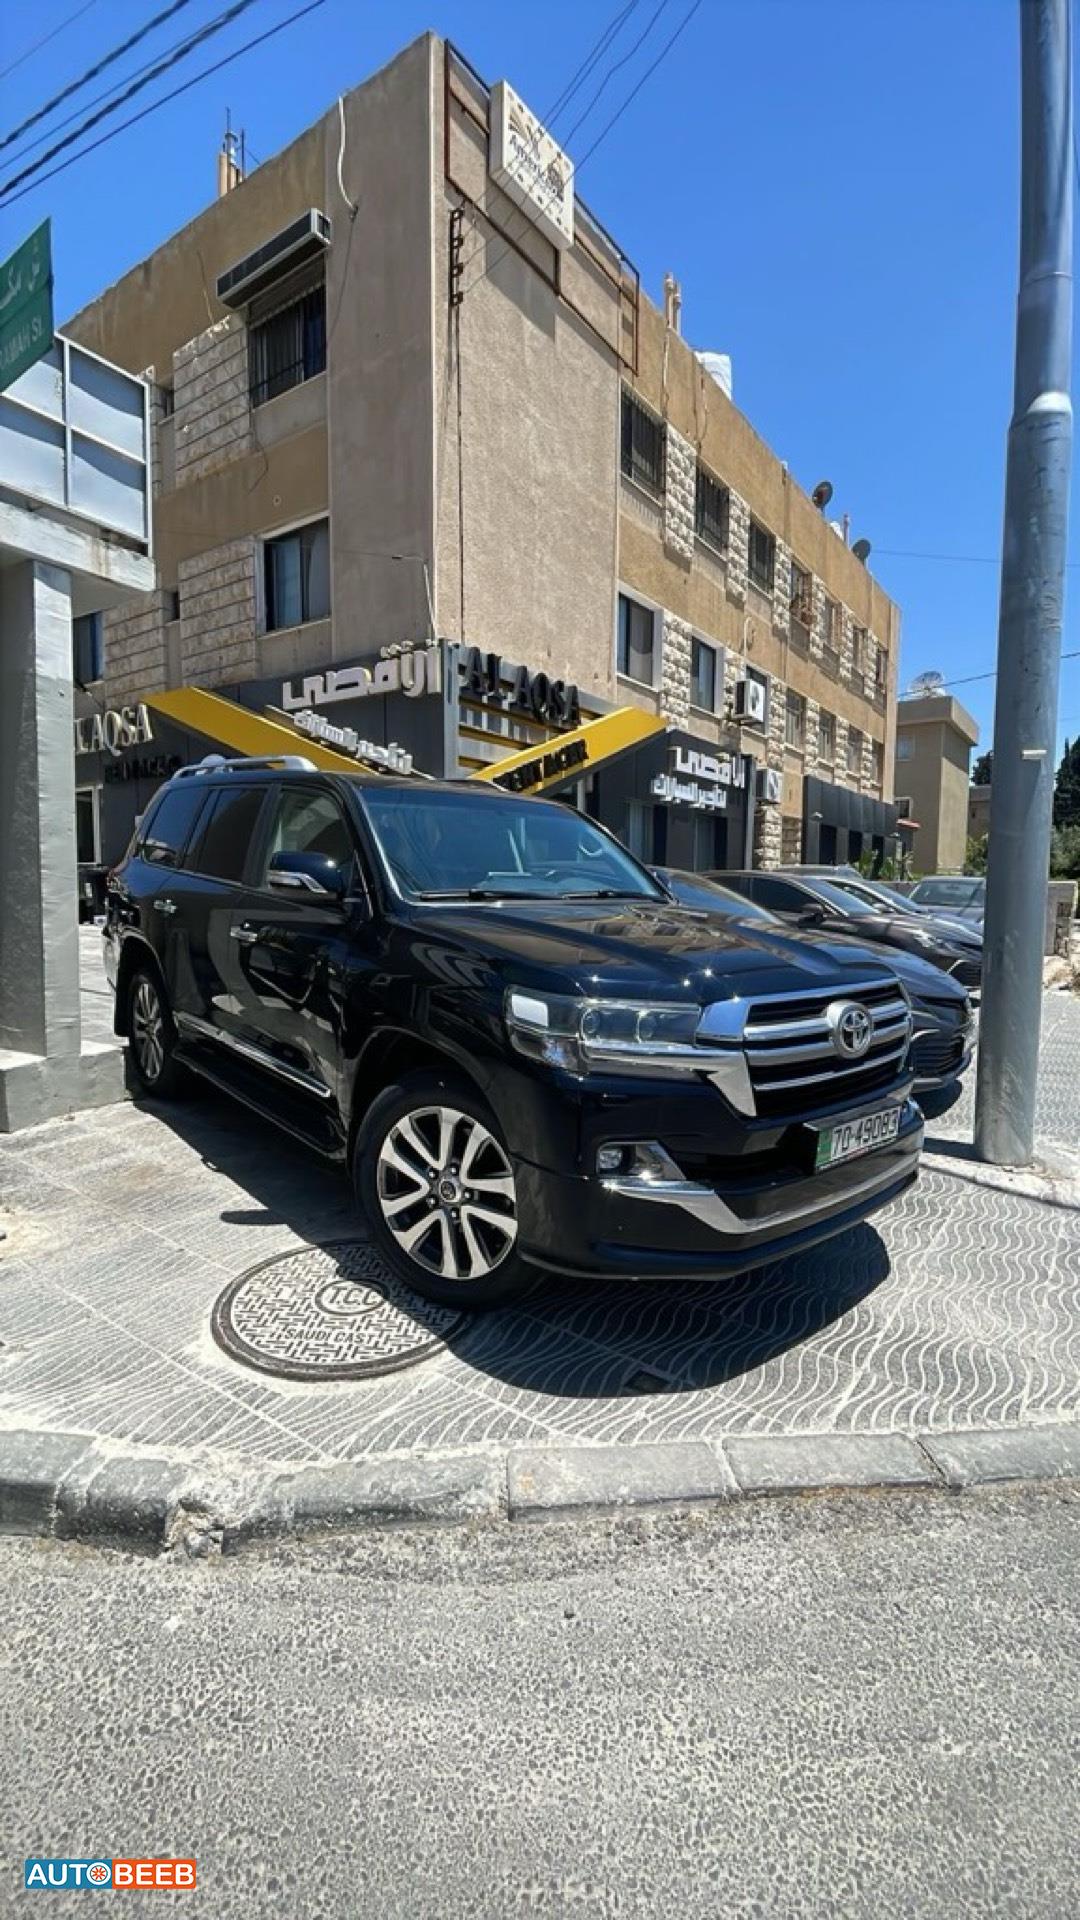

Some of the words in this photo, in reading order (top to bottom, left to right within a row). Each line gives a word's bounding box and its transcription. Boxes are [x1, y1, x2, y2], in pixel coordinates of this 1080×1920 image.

[833, 1110, 899, 1157] 70-49083
[285, 1328, 332, 1341] SAUDI
[334, 1331, 378, 1345] CAST
